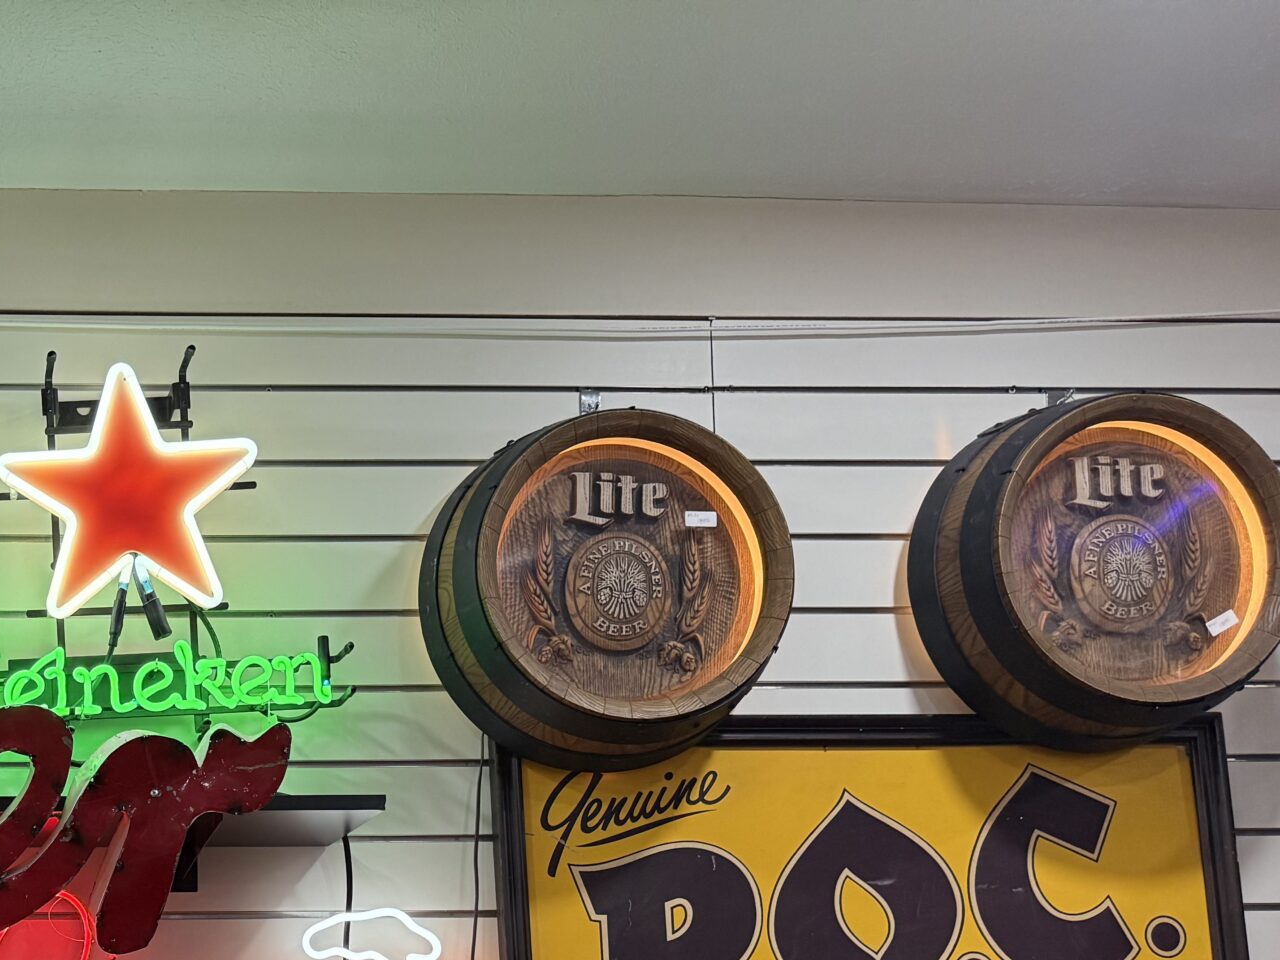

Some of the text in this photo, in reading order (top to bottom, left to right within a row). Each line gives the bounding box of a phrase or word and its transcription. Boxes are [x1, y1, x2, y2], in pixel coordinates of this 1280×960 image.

[569, 471, 669, 527] Lite
[1066, 455, 1165, 511] Lite
[578, 540, 663, 598] A FINE PILSNER
[1084, 523, 1167, 579] A FINE PILSNER
[592, 617, 648, 635] BEER
[1100, 600, 1155, 619] BEER
[540, 770, 732, 878] Genuine
